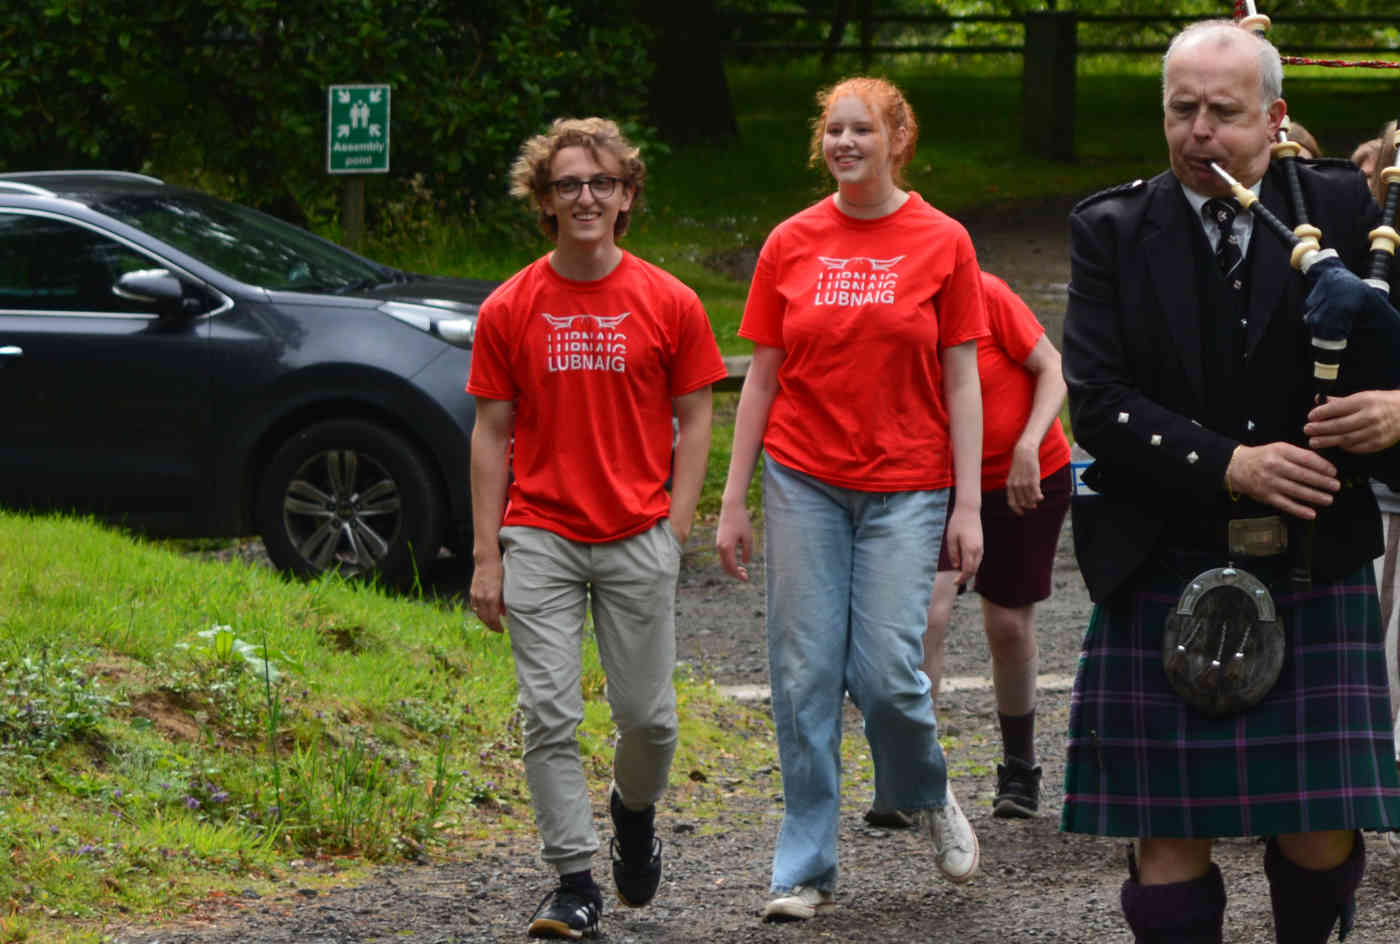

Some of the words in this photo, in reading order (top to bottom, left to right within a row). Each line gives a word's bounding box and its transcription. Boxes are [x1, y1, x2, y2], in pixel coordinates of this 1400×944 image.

[334, 142, 384, 153] Assembly
[346, 156, 372, 167] point
[814, 291, 895, 307] LUBNAIG
[548, 355, 625, 373] LUBNAIG
